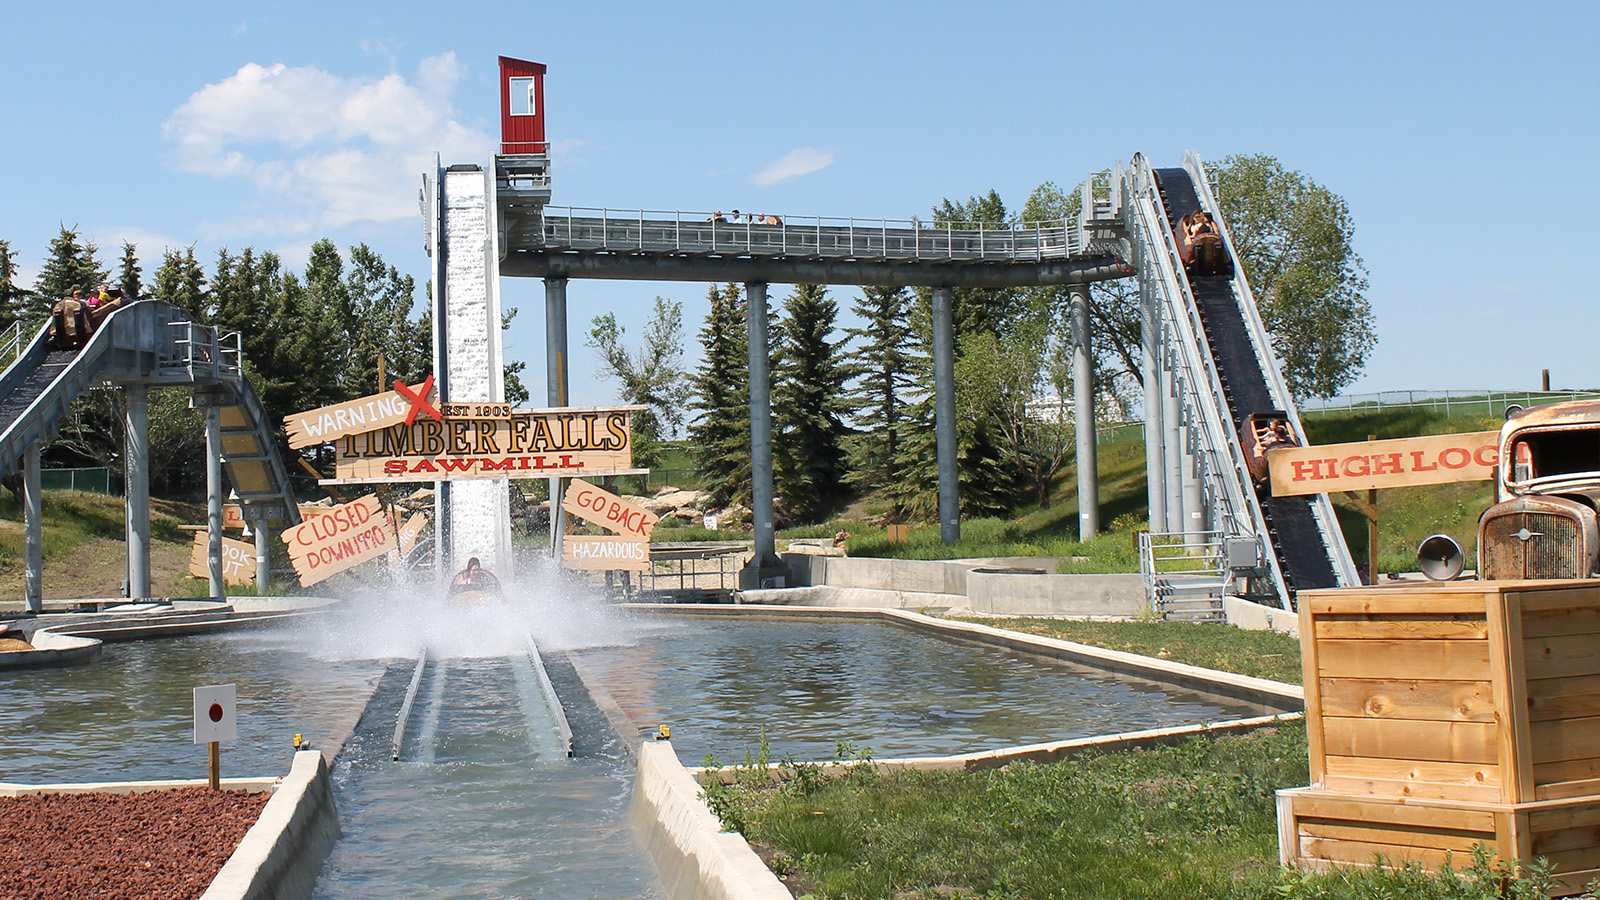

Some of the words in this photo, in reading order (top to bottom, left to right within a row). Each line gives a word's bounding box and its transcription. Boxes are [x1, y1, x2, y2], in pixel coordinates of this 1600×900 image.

[301, 394, 407, 438] WARNING
[442, 405, 470, 417] EST
[475, 405, 511, 417] 1903
[342, 418, 501, 458] TIMBER
[507, 412, 628, 454] FALLS
[383, 454, 584, 474] SAWMILL
[1291, 452, 1404, 482] HIGH
[296, 502, 371, 546] CLOSED
[577, 490, 606, 512] GO
[606, 502, 650, 536] BACK
[572, 541, 645, 560] HAZARDOUS
